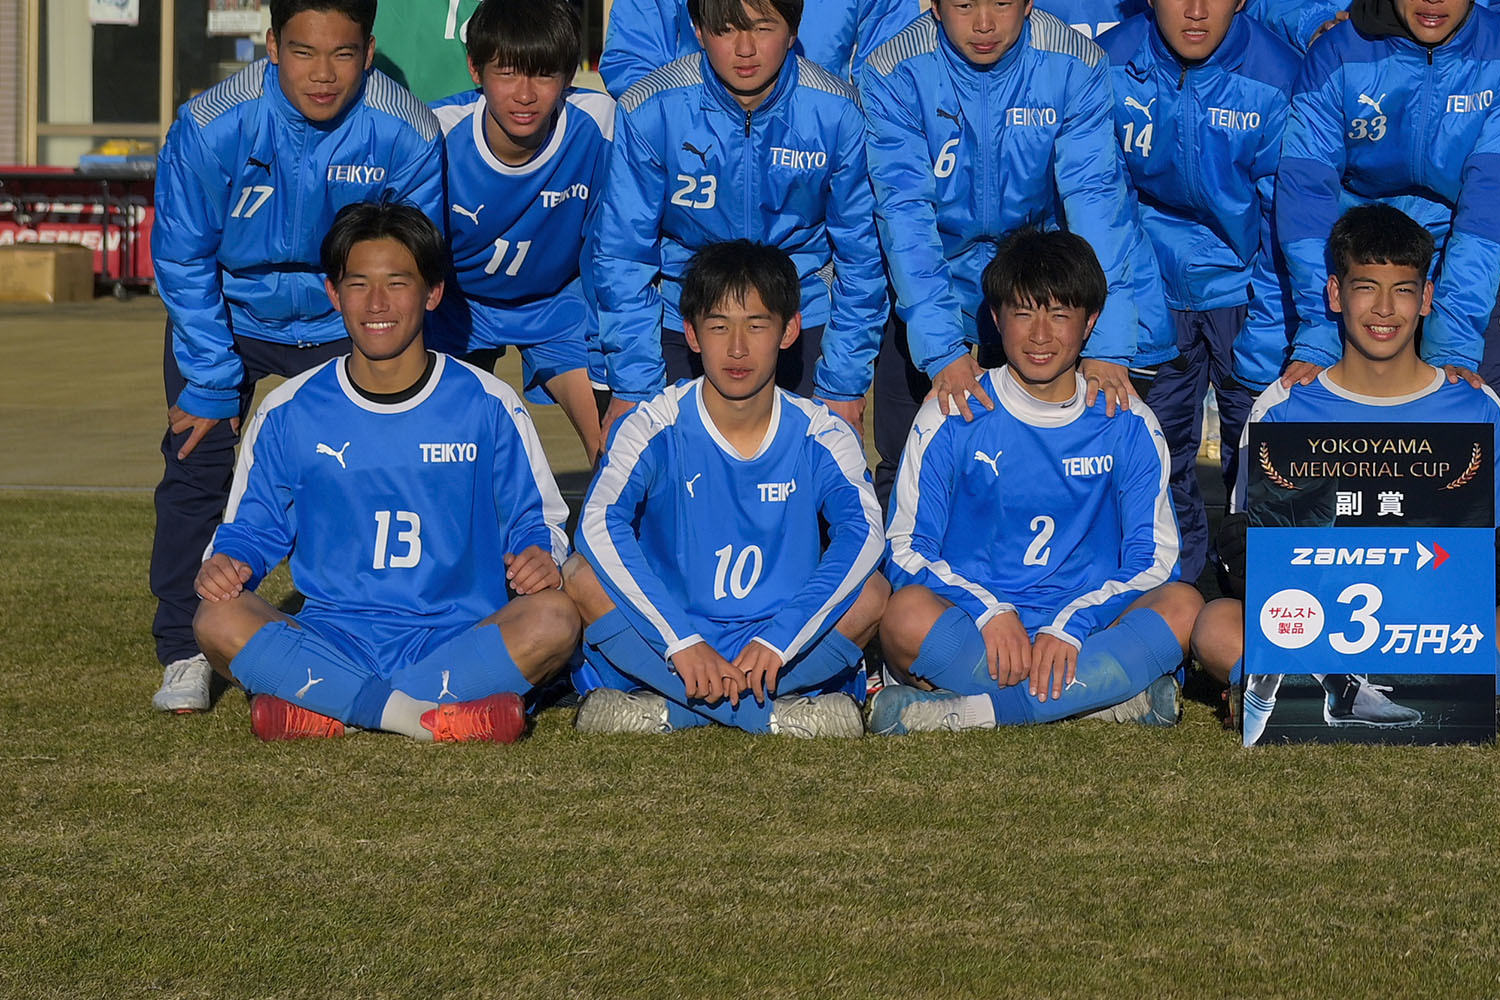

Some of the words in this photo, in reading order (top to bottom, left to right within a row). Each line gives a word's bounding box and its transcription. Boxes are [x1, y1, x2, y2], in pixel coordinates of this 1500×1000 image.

[1446, 89, 1494, 113] TEIKYO
[1005, 107, 1057, 127] TEIKYO
[1207, 107, 1261, 130] TEIKYO
[1348, 115, 1387, 141] 33
[1123, 122, 1153, 157] 14
[770, 147, 827, 169] TEIKYO
[934, 138, 960, 178] 6
[327, 164, 385, 184] TEIKYO
[231, 185, 275, 218] 17
[671, 174, 717, 209] 23
[484, 237, 531, 276] 11
[419, 442, 477, 463] TEIKYO
[1307, 438, 1433, 454] YOKOYAMA
[1062, 454, 1113, 477] TEIKYO
[1290, 461, 1404, 478] MEMORIAL
[1409, 461, 1450, 478] CUP
[757, 478, 797, 502] TEIK
[1335, 490, 1404, 517] 副賞
[372, 510, 422, 570] 13
[1024, 515, 1055, 566] 2
[713, 544, 763, 601] 10
[1267, 606, 1317, 619] ザムスト
[1277, 621, 1305, 635] 製品
